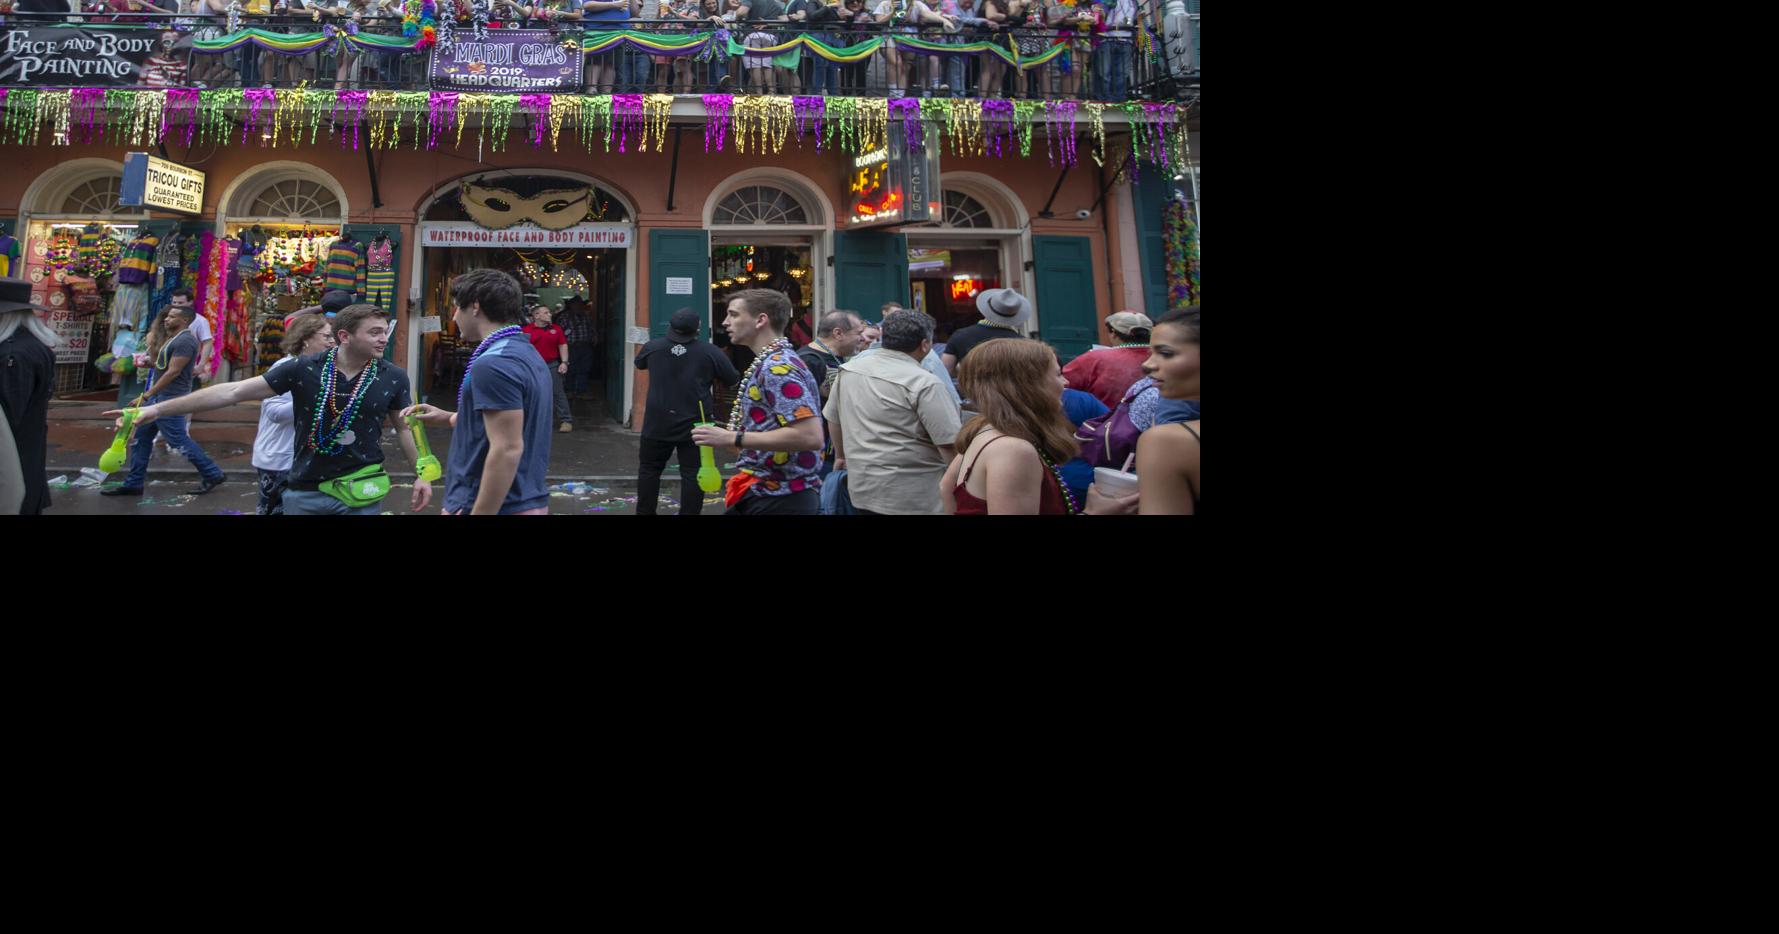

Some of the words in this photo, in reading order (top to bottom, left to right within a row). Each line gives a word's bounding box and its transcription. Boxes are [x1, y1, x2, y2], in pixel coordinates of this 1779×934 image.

[4, 30, 61, 54] FACE
[62, 38, 95, 52] AND
[93, 33, 155, 56] BODY
[453, 42, 514, 65] MARDI
[519, 43, 567, 65] GRAS
[13, 56, 131, 81] PAINTING
[490, 67, 522, 76] 2019
[450, 74, 562, 88] HEADQUARTERS
[148, 169, 179, 188] TRICOU
[181, 178, 203, 194] GIFTS
[154, 187, 195, 202] GUARANTEED
[148, 194, 175, 206] LOWEST
[176, 200, 198, 211] PRICES
[430, 230, 493, 242] WATERPROOF
[497, 231, 520, 243] FACE
[524, 231, 544, 243] AND
[548, 231, 574, 243] BODY
[578, 231, 626, 243] PAINTING
[56, 321, 88, 330] T-SHIRTS
[69, 338, 88, 348] $20
